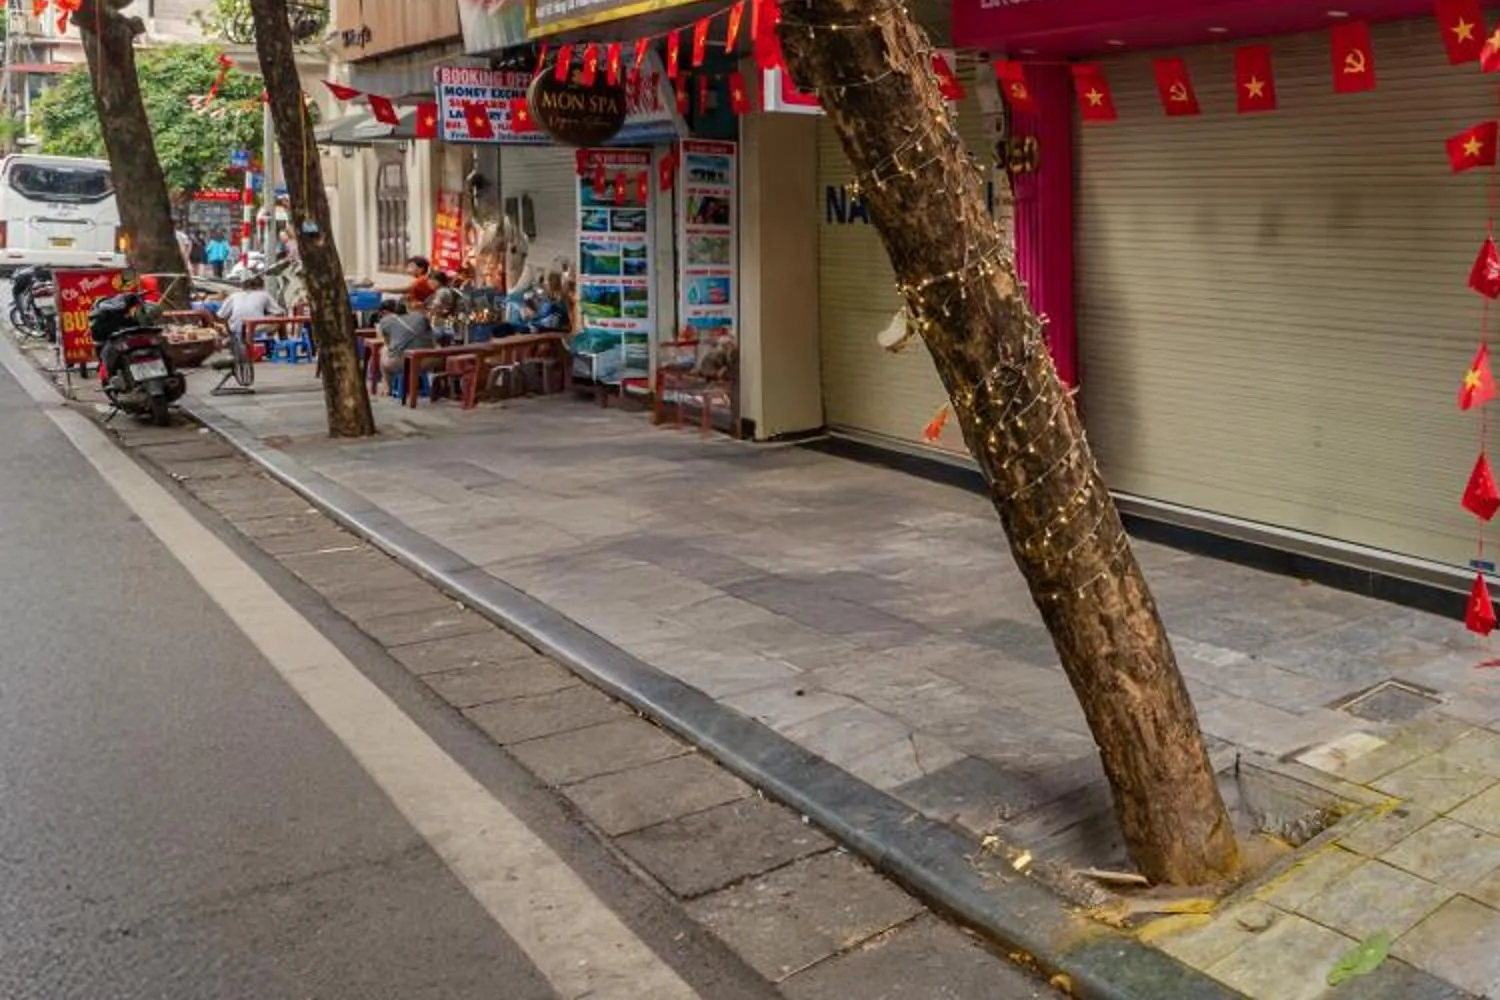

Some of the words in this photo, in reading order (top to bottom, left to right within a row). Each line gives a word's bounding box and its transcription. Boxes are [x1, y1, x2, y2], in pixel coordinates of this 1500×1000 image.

[441, 67, 503, 89] BOOKING
[444, 85, 487, 97] MONEY
[491, 87, 527, 99] EXCHA
[541, 90, 586, 111] MON
[588, 95, 619, 115] SPA
